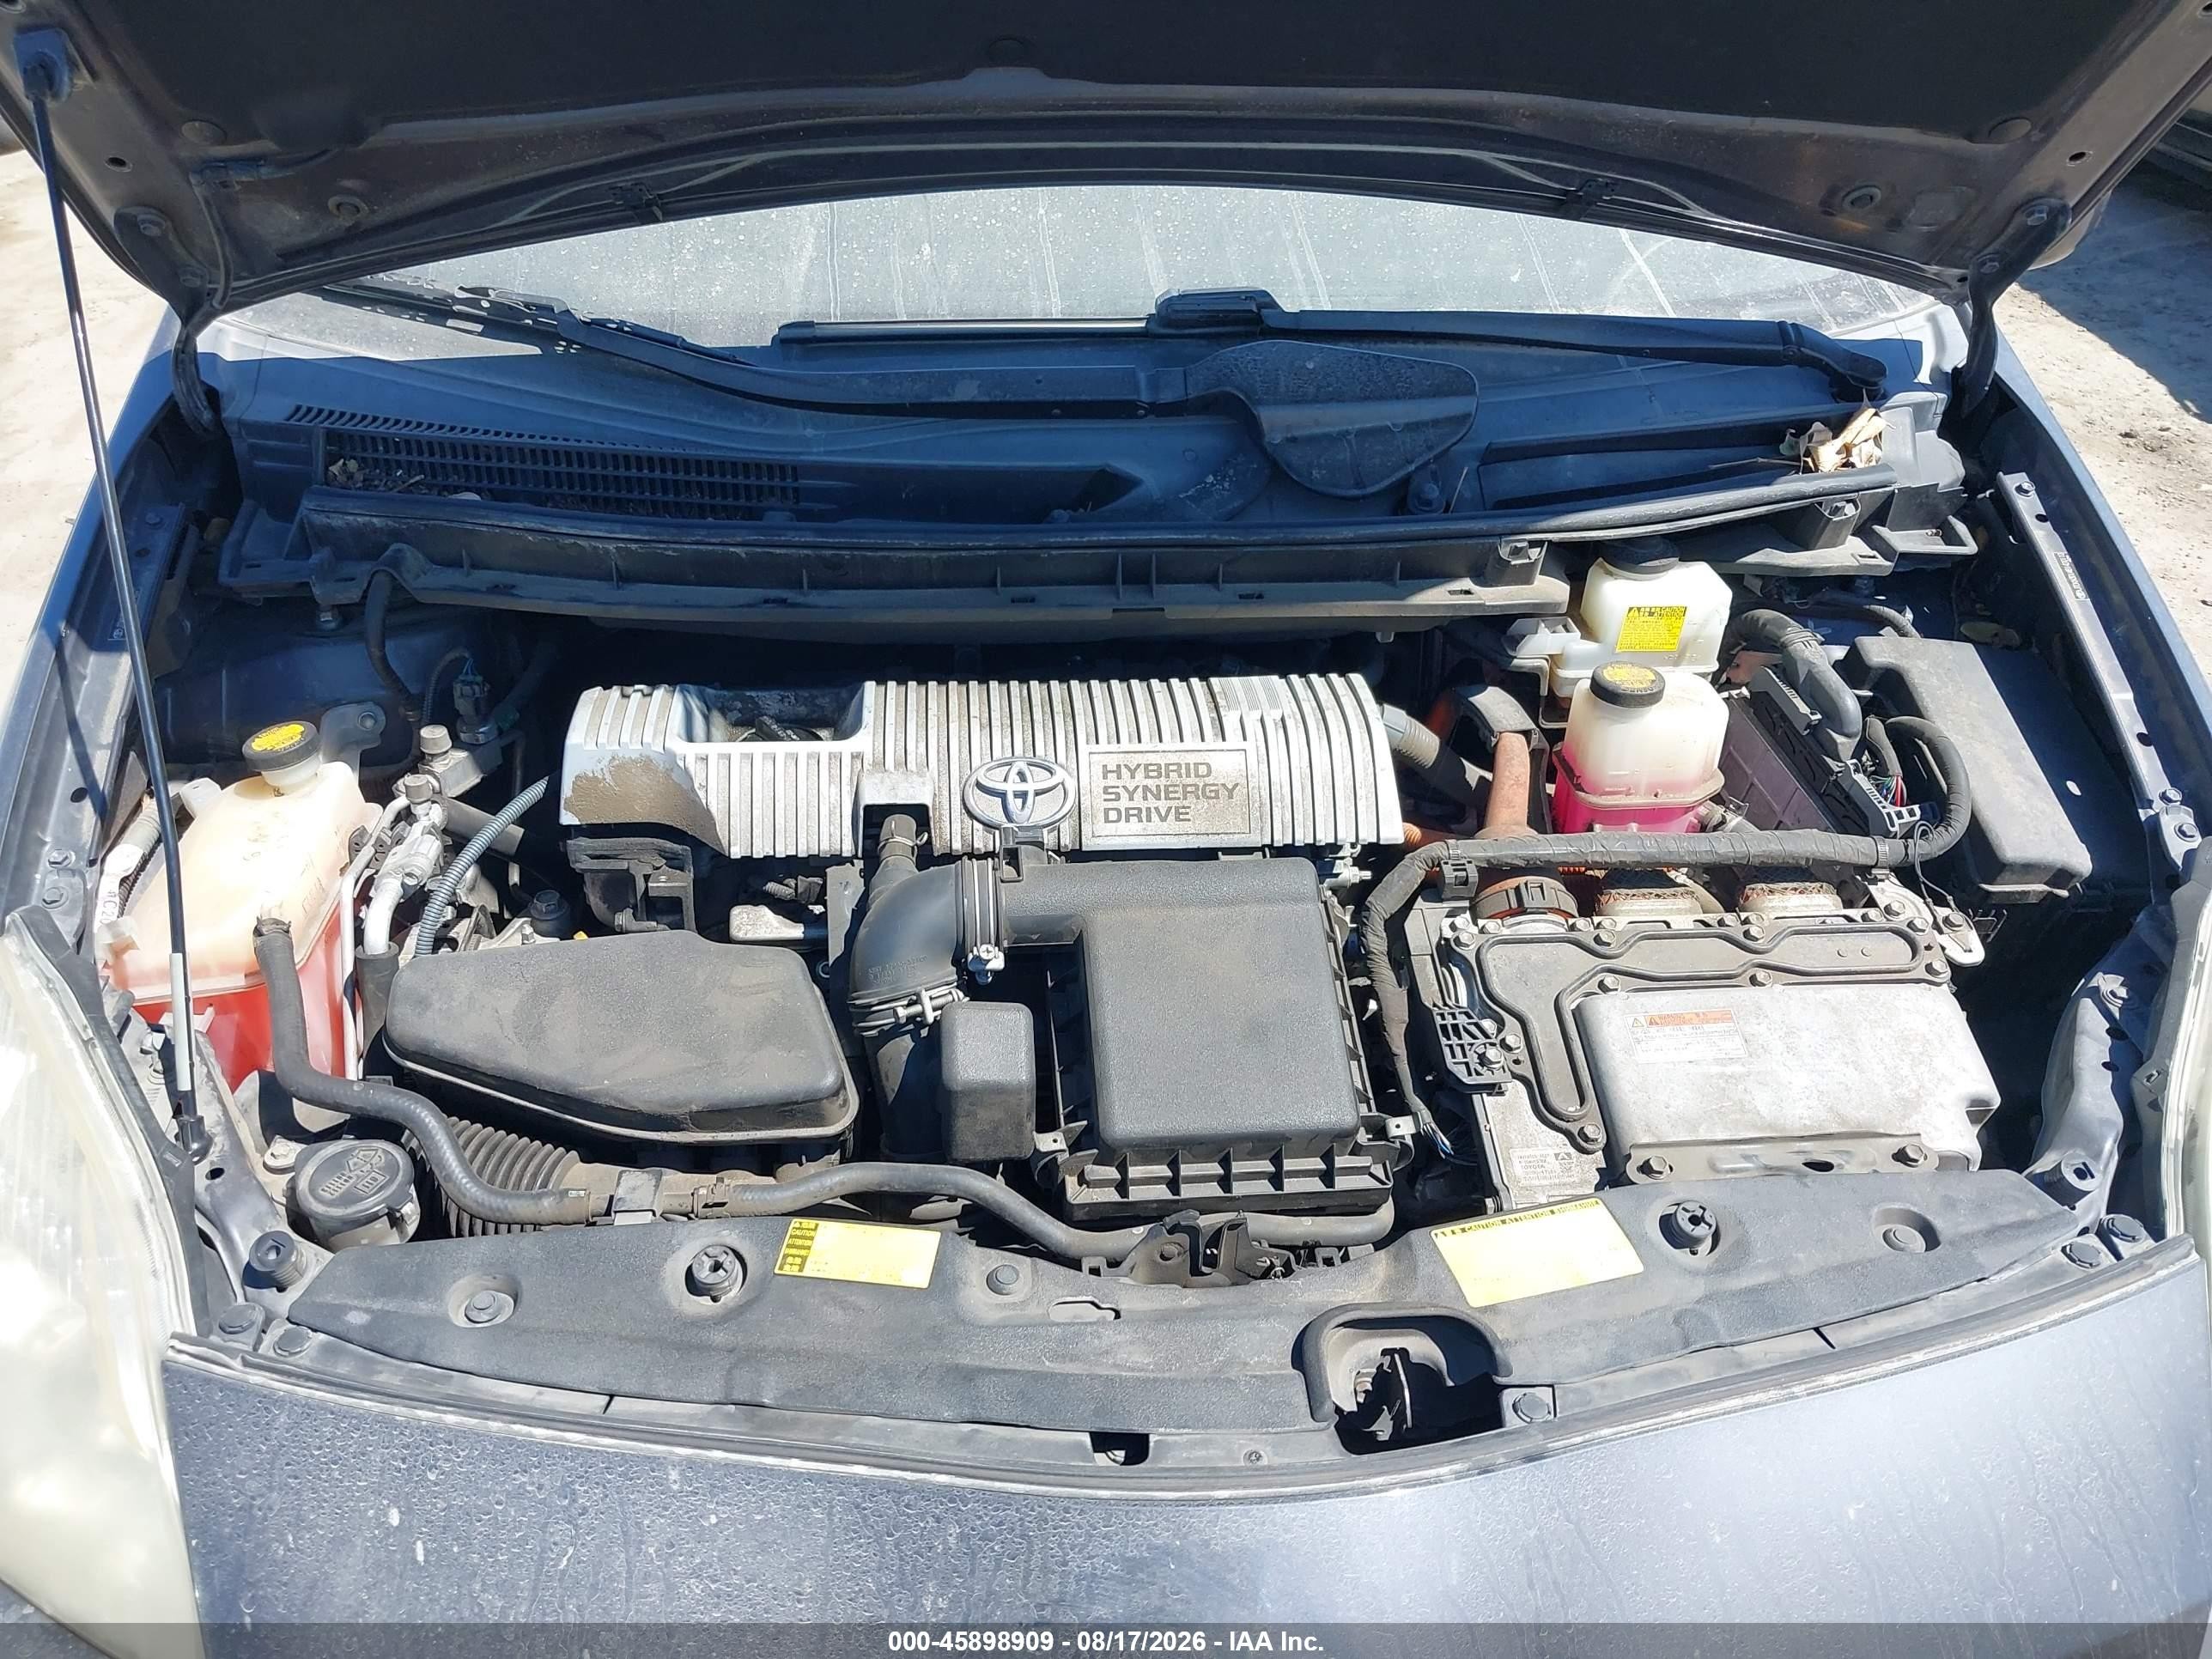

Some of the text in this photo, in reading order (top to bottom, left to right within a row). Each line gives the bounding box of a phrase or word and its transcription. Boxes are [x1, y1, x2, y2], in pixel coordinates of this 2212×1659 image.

[1102, 762, 1212, 781] HYBRID
[1103, 782, 1240, 802] SYNERGY
[1103, 805, 1192, 823] DRIVE
[1465, 1219, 1501, 1232] CAUTION
[1505, 1211, 1551, 1224] ATTENTION
